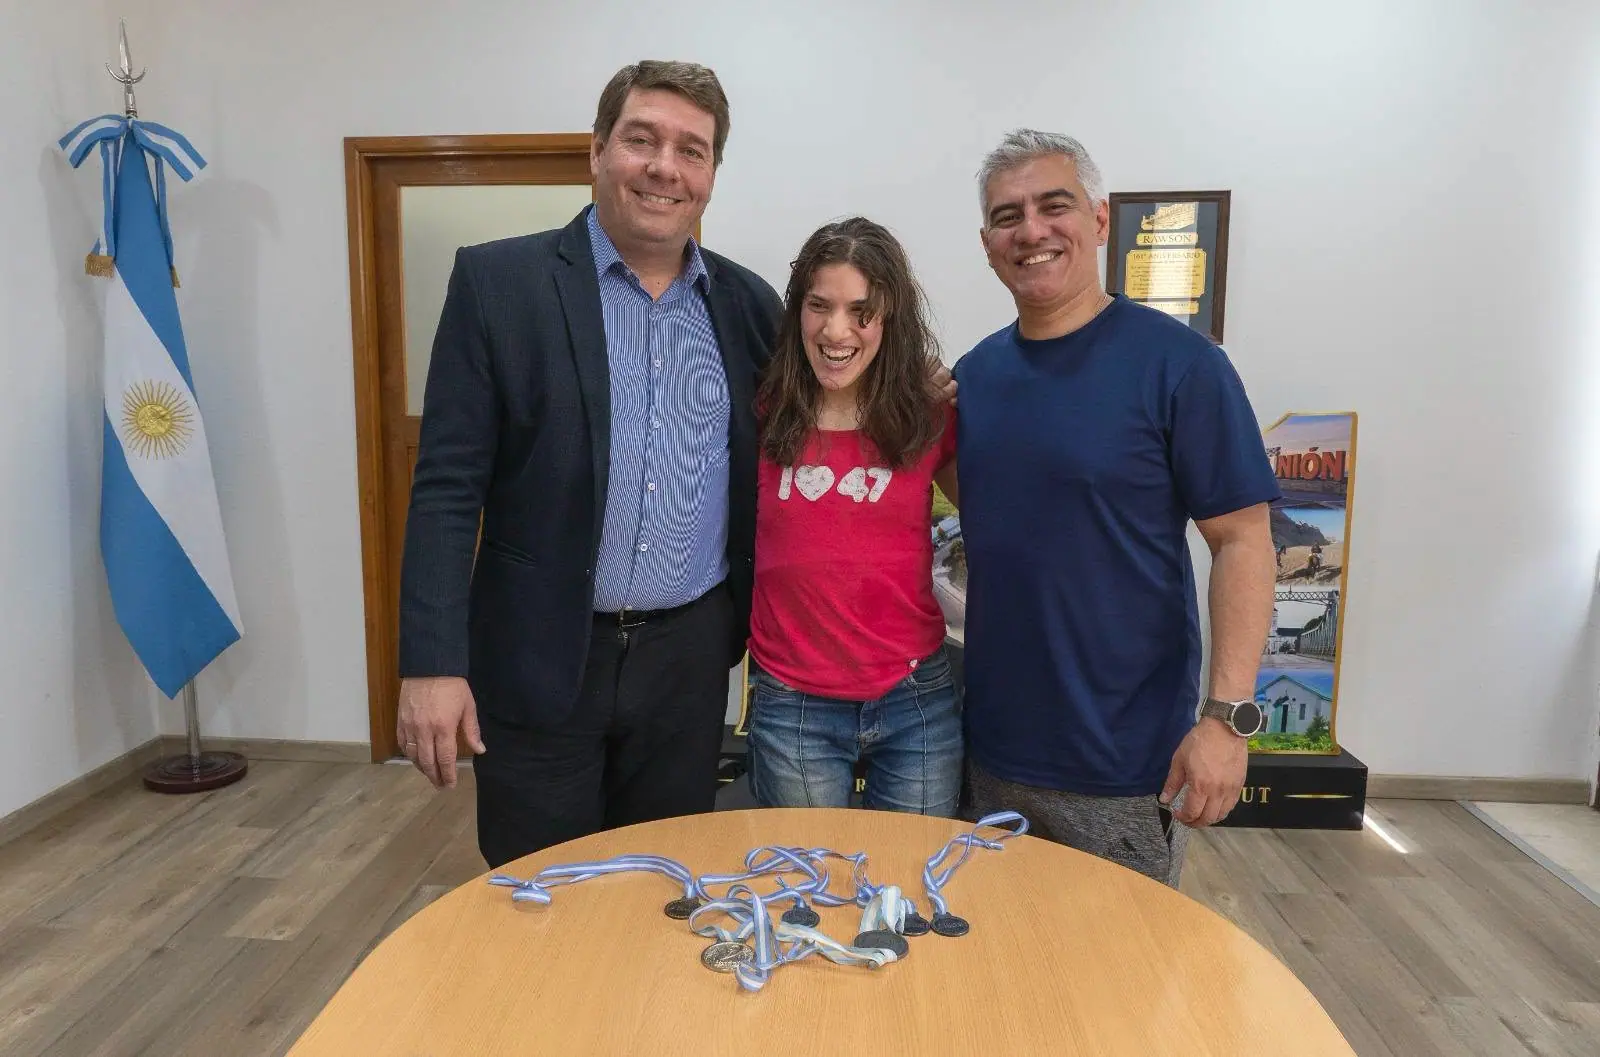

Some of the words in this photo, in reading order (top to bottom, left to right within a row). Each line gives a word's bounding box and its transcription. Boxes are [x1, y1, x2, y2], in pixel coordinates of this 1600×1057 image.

[1143, 234, 1191, 243] RAWSON
[1148, 252, 1201, 260] ANIVERSARIO
[837, 466, 893, 502] 47
